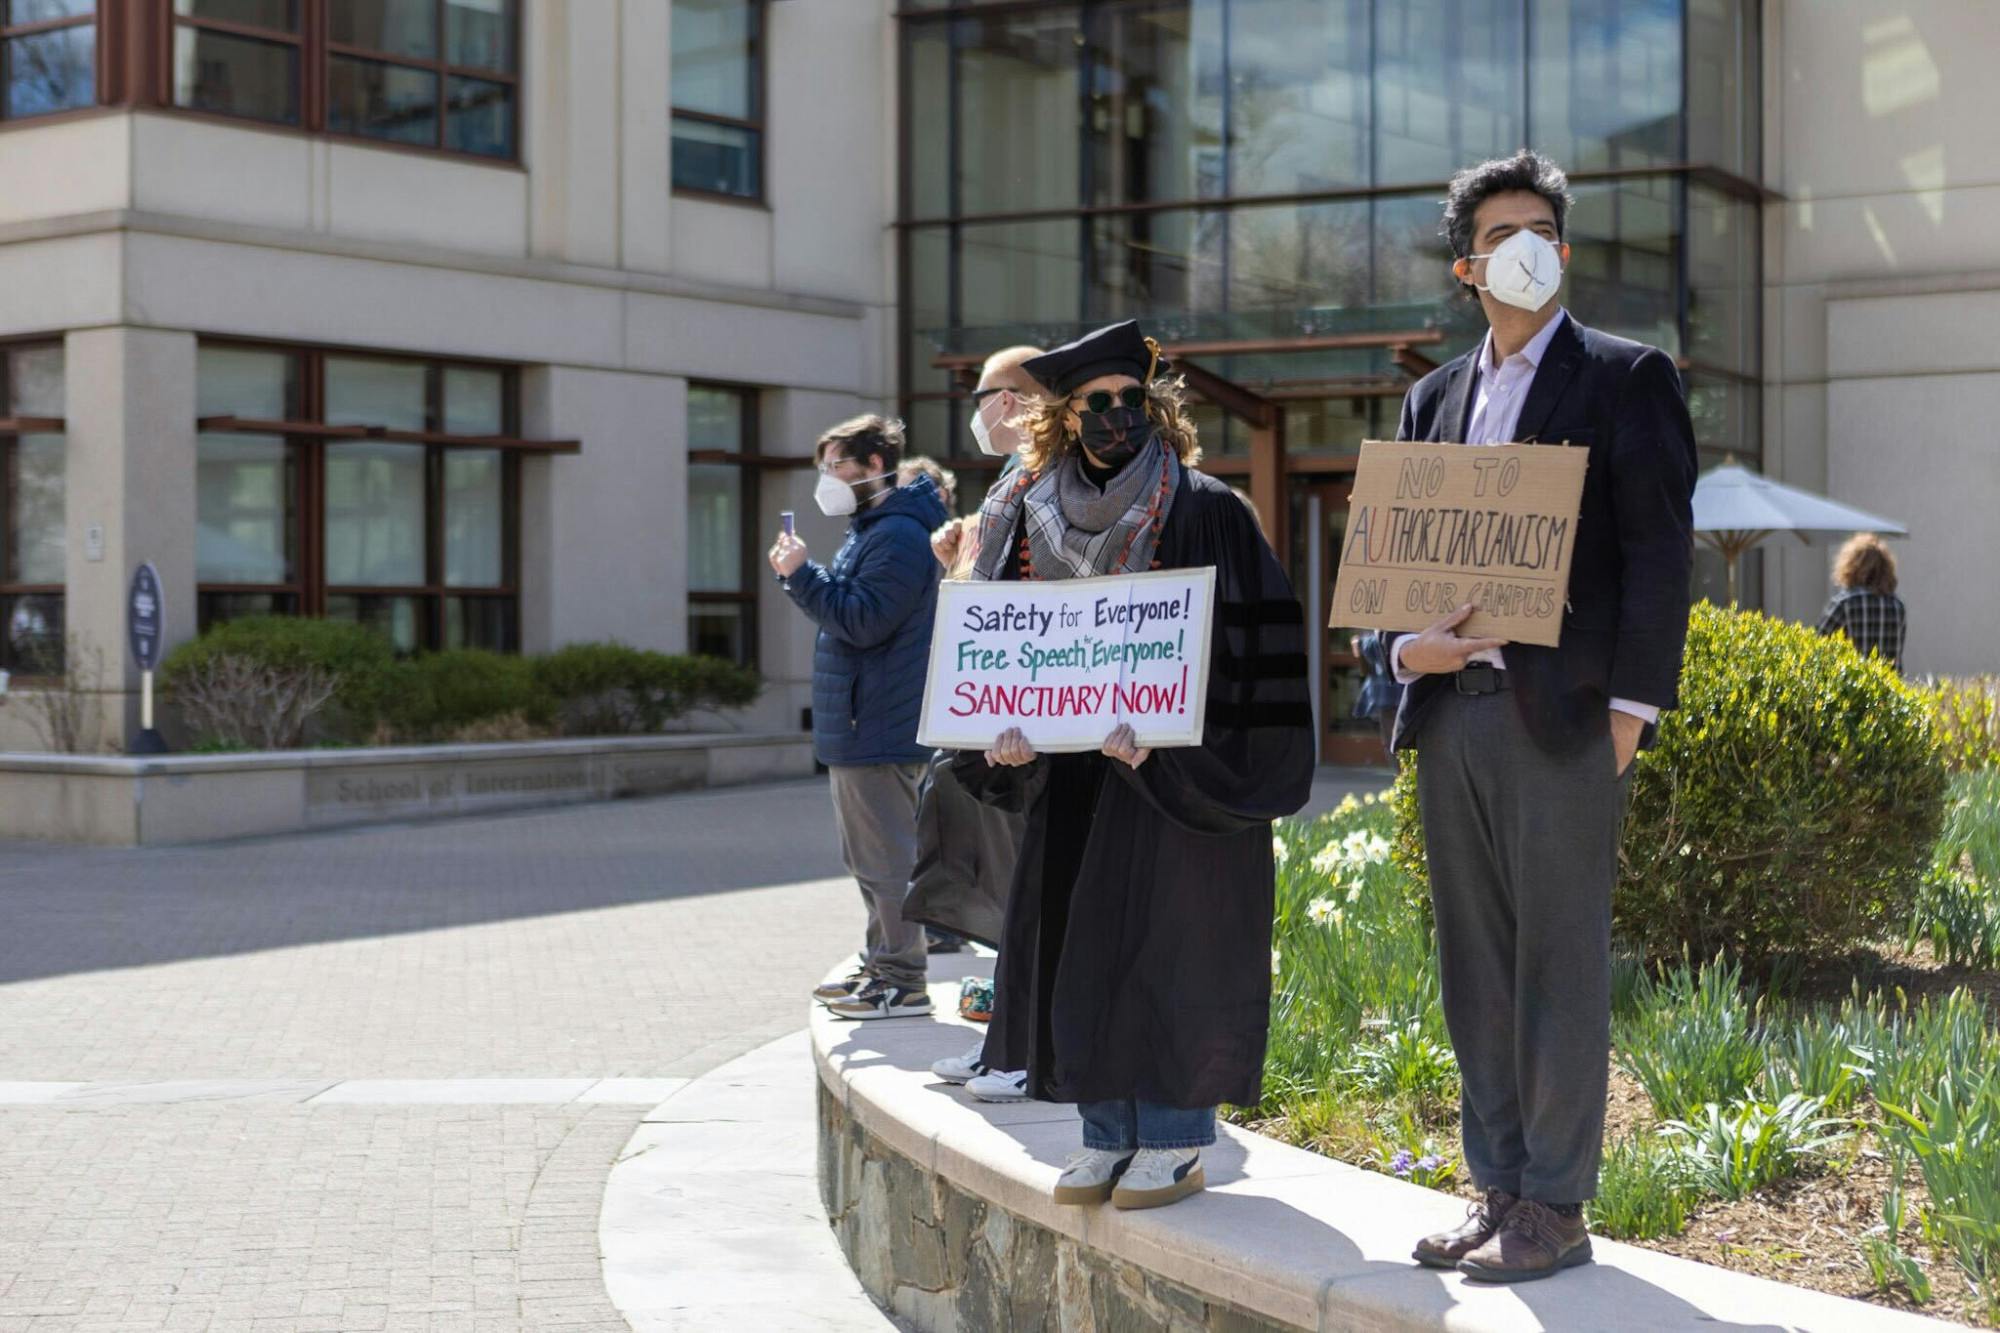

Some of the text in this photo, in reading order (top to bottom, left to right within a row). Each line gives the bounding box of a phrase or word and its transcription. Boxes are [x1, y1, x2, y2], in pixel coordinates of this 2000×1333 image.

[1396, 456, 1520, 500] NO TO
[1344, 506, 1568, 571] AUTHORITARIANISM
[963, 588, 1192, 636] Safety for Everyone!
[1351, 579, 1555, 618] ON OUR CAMPUS
[957, 639, 1010, 672] Free
[1018, 639, 1086, 682] Speech
[1092, 629, 1185, 674] Everyone!
[949, 665, 1188, 718] SANCTUARY NOW!
[337, 773, 421, 803] School
[428, 774, 454, 798] of
